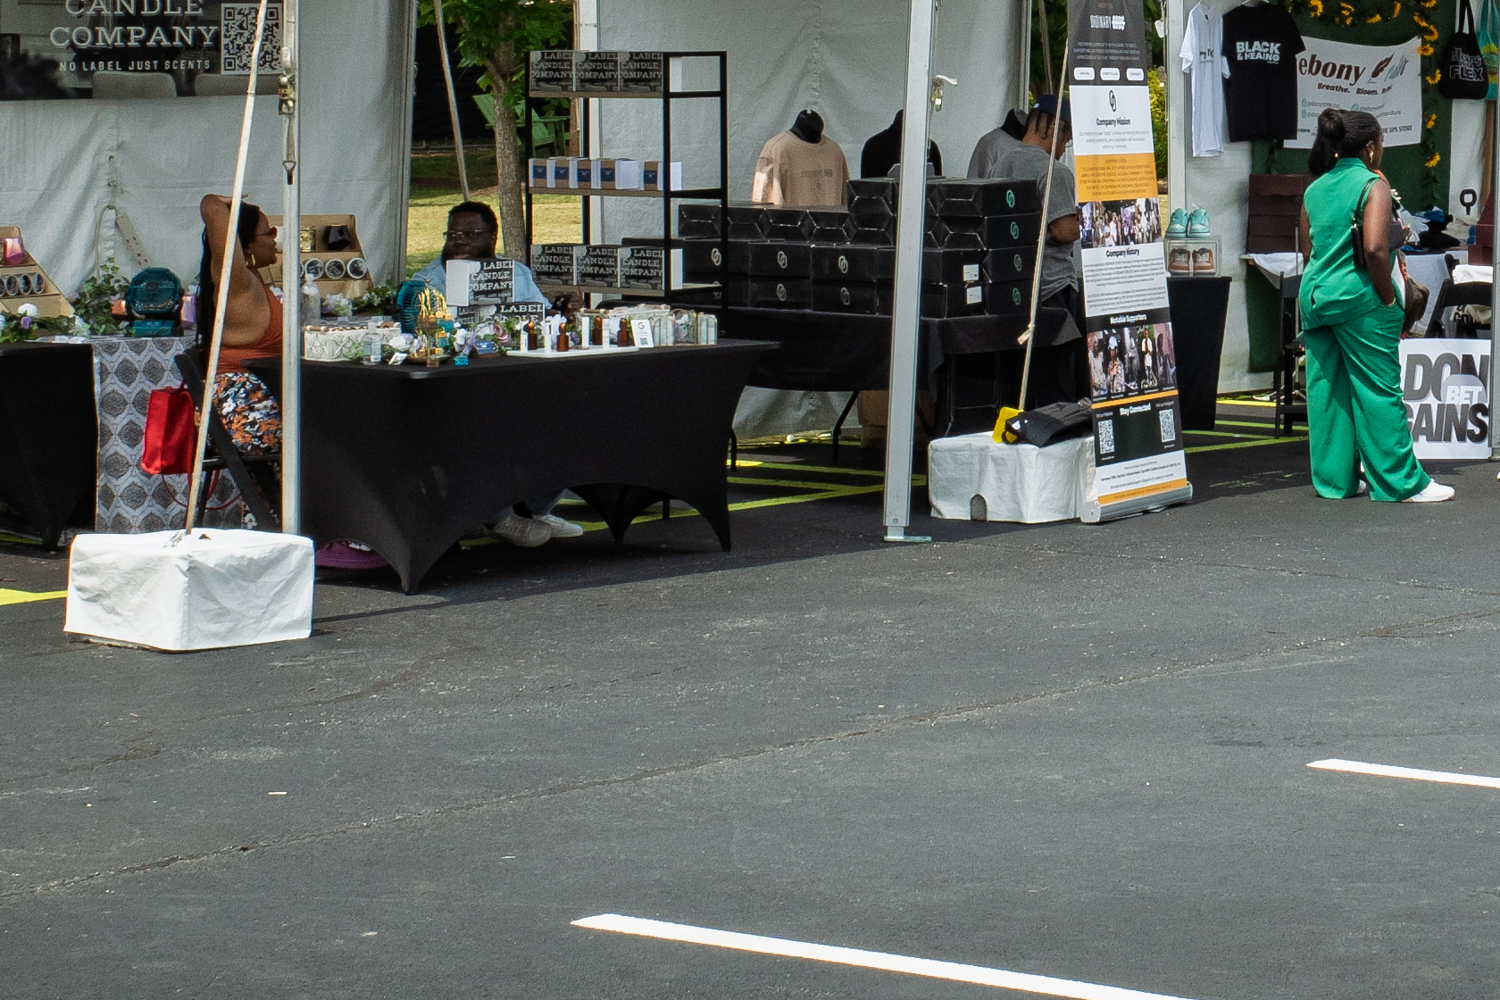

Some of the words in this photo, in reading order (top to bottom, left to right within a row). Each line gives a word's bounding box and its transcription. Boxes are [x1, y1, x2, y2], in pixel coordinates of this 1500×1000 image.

[50, 26, 219, 48] COMPANY
[1235, 41, 1281, 54] BLACK
[1236, 53, 1243, 61] &
[60, 61, 76, 71] NO
[82, 60, 123, 71] LABEL
[128, 60, 159, 70] JUST
[164, 59, 210, 70] SCENTS
[1299, 54, 1366, 86] ebony
[1450, 65, 1484, 81] FLEX
[1317, 82, 1350, 94] Breathe.
[544, 246, 574, 254] LABEL
[589, 247, 618, 256] LABEL
[633, 249, 663, 257] LABEL
[533, 255, 571, 263] CANDLE
[579, 257, 615, 265] CANDLE
[622, 259, 660, 267] CANDLE
[483, 260, 514, 270] LABEL
[471, 271, 510, 280] CANDLE
[500, 304, 543, 313] LABEL
[1446, 385, 1483, 404] BET
